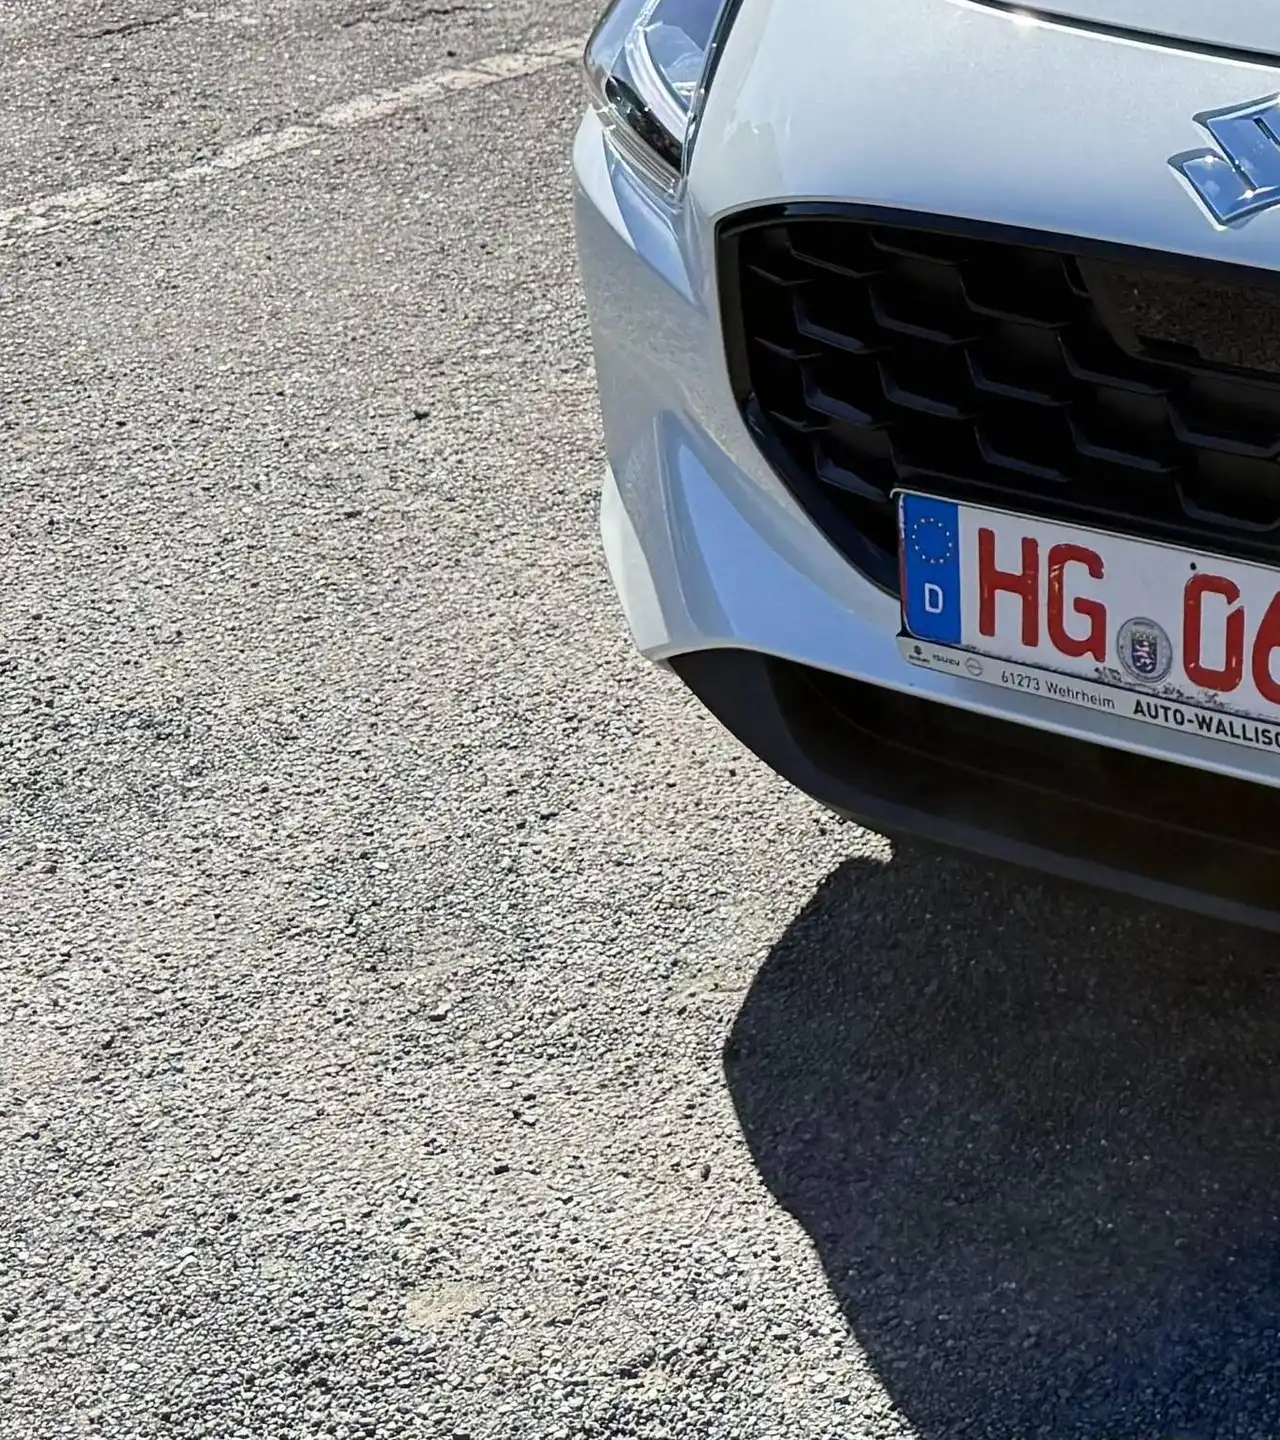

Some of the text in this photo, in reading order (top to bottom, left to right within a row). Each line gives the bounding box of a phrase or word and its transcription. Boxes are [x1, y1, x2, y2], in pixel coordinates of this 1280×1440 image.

[923, 582, 945, 616] D
[976, 526, 1107, 663] HG
[1000, 670, 1116, 710] 61273 Wehrheim
